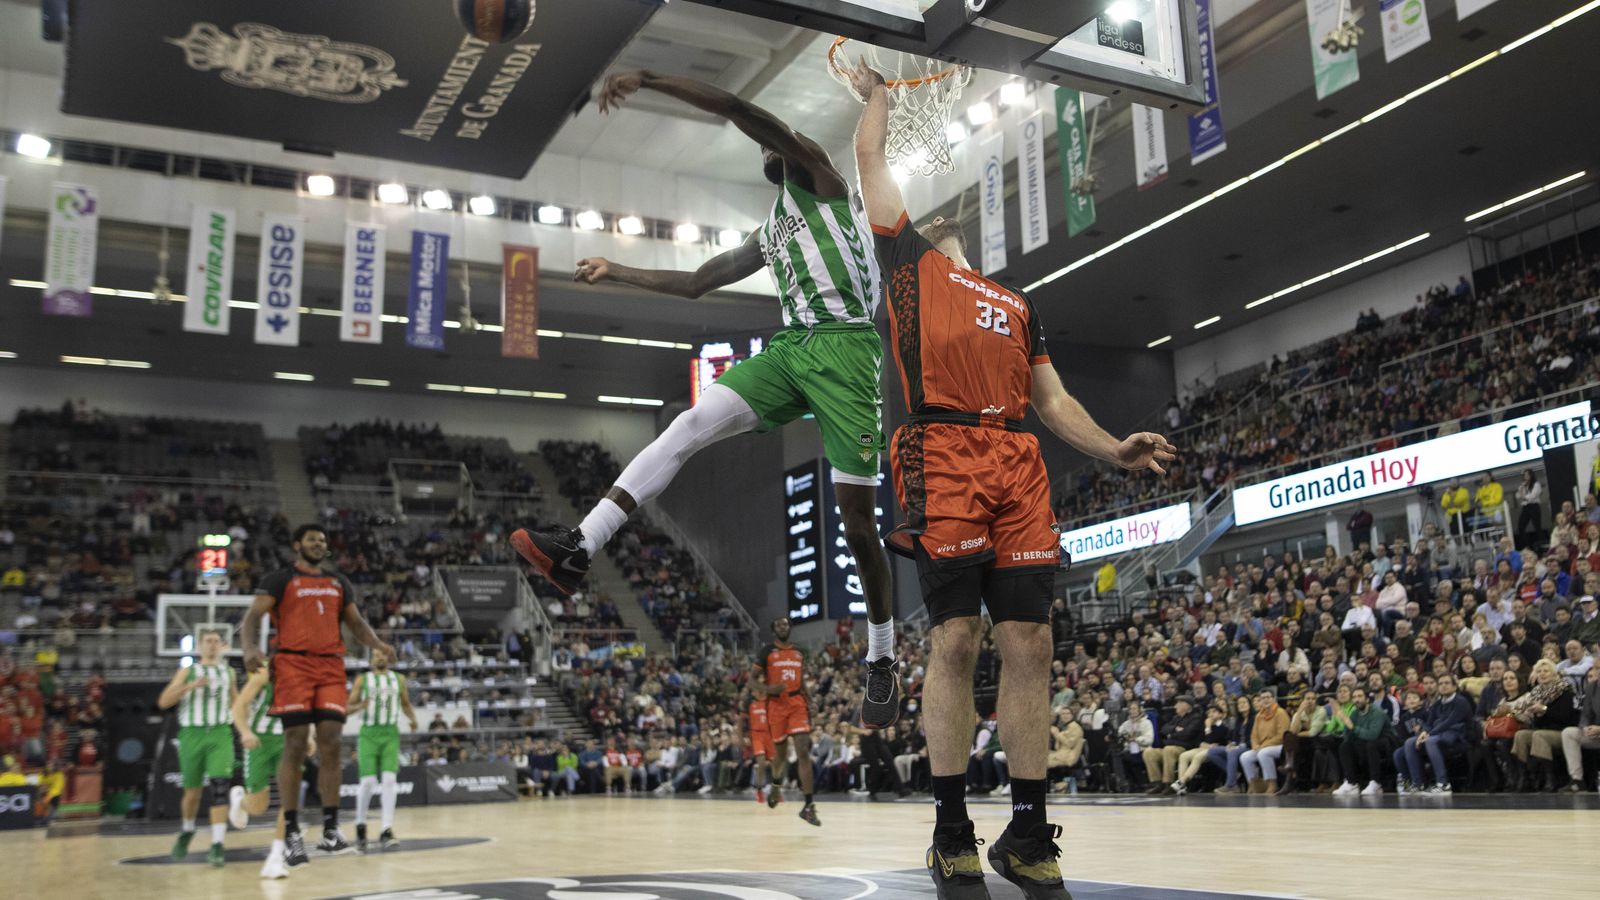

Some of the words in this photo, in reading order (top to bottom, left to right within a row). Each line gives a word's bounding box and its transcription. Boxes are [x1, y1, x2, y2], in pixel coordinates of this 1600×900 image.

[1100, 34, 1142, 52] endesa
[399, 33, 489, 141] AYUNTAMIENT
[462, 43, 542, 118] GRANADA
[456, 121, 488, 139] DE
[267, 223, 295, 308] asisa
[353, 228, 377, 314] BERNER
[417, 231, 437, 289] Motor
[415, 290, 433, 335] Mica
[975, 299, 1011, 337] 32
[1269, 465, 1366, 509] Granada
[1370, 455, 1420, 487] Hoy
[1127, 519, 1161, 545] Hoy
